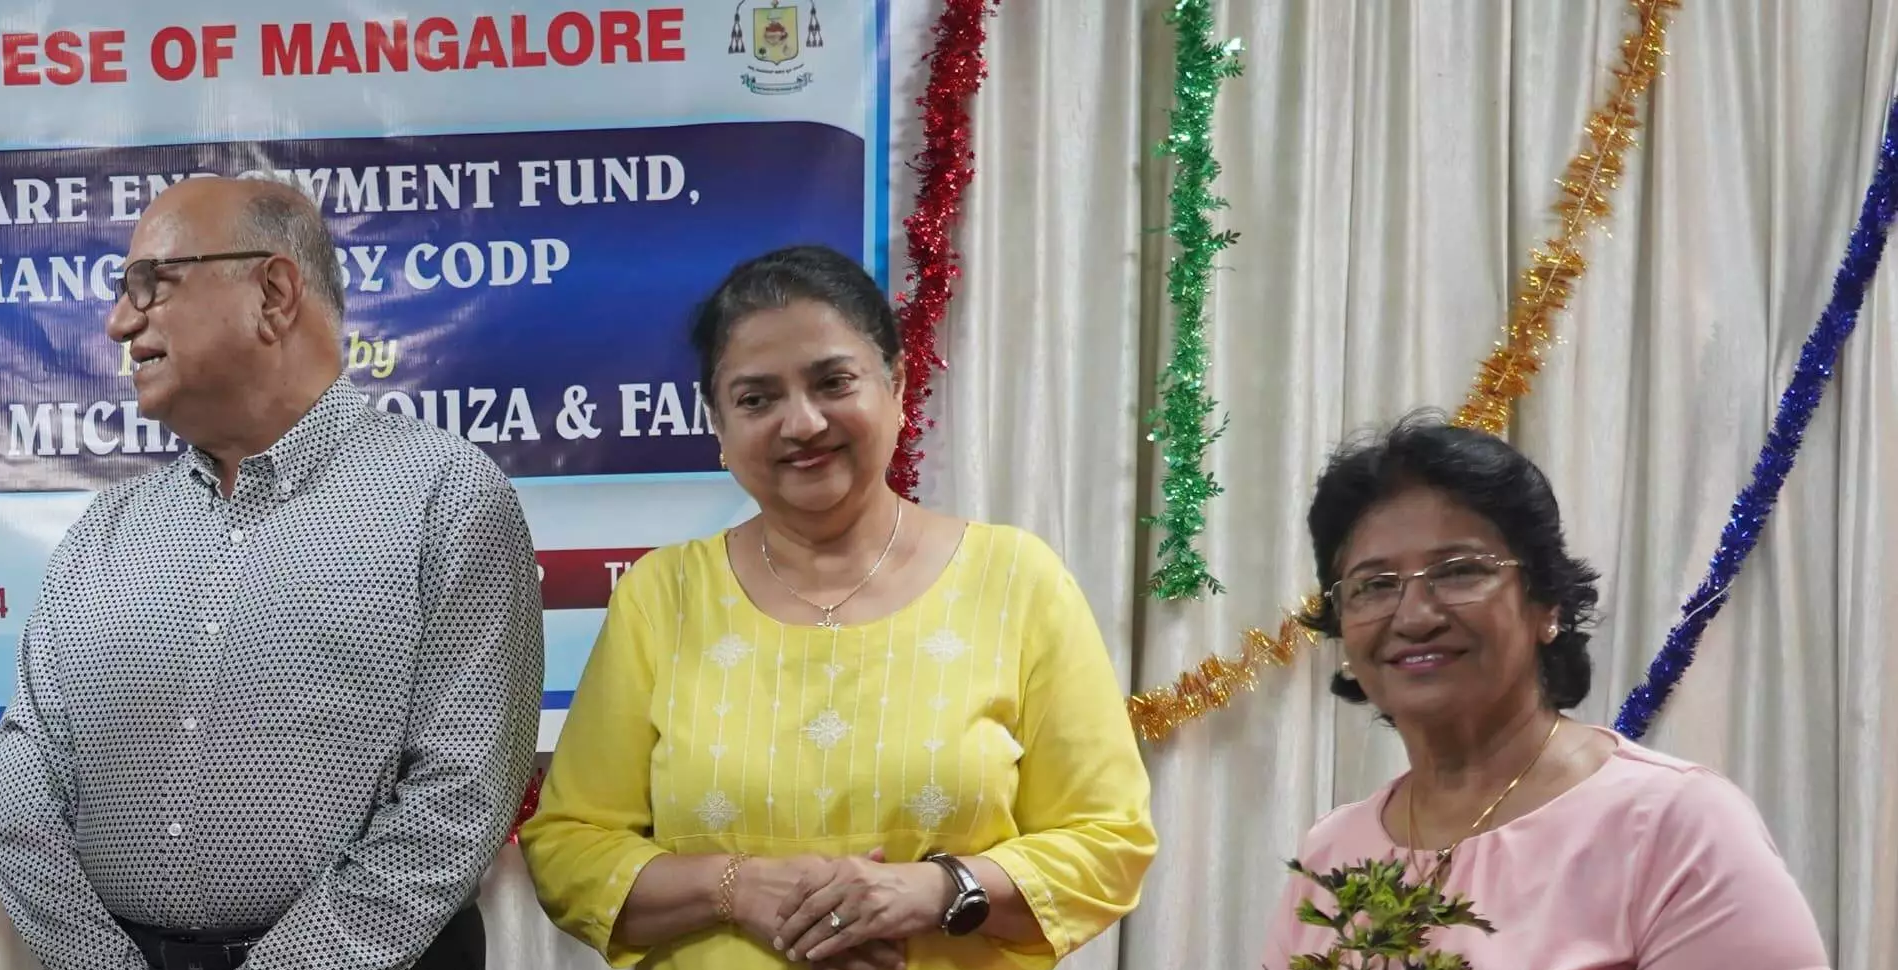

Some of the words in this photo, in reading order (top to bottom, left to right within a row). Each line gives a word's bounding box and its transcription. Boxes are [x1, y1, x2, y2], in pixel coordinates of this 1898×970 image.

[150, 24, 237, 82] OF
[261, 8, 686, 76] MANGALORE
[518, 154, 700, 207] FUND,
[404, 238, 570, 290] CODP
[347, 330, 397, 378] by
[555, 384, 601, 440] &
